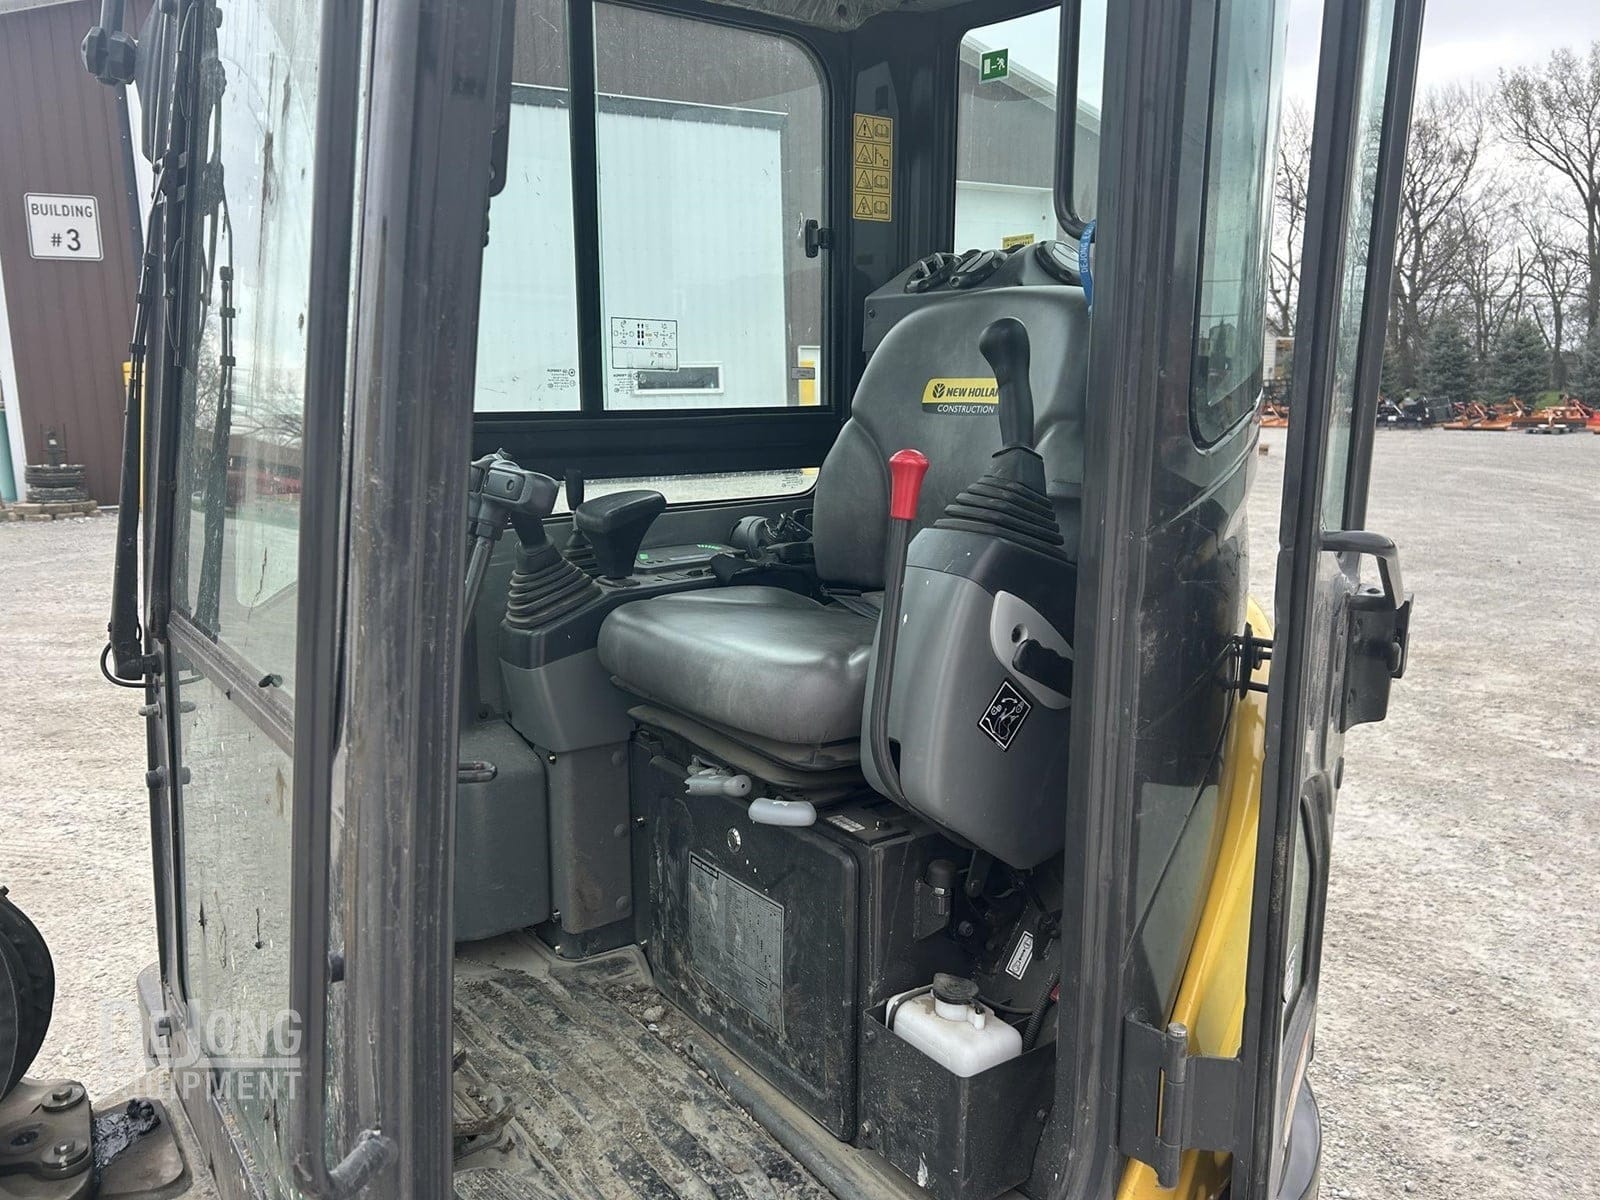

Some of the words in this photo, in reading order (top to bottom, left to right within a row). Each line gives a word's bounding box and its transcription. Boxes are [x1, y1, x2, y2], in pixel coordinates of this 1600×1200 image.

[31, 203, 93, 218] BUILDING
[1079, 241, 1089, 273] DEJONG
[946, 387, 967, 397] NEW
[937, 404, 995, 414] CONSTRUCTION
